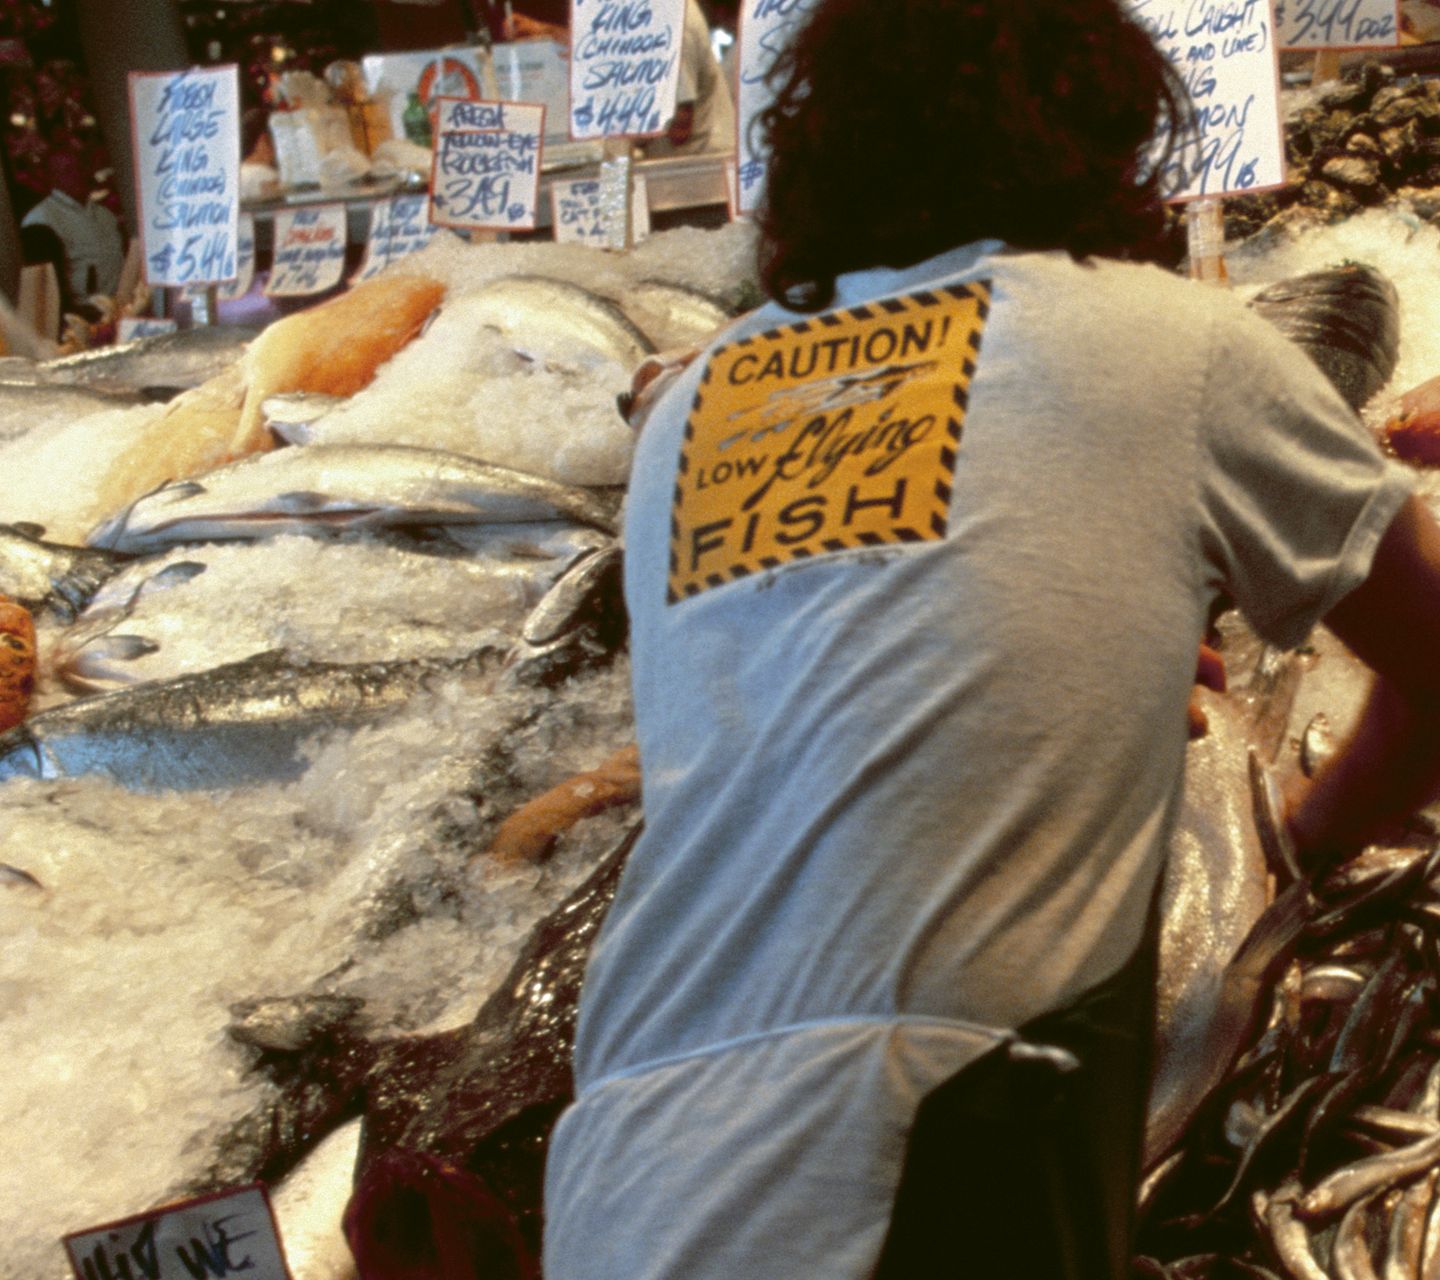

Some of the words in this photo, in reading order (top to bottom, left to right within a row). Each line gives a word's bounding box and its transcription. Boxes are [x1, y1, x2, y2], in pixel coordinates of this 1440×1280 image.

[591, 0, 653, 34] KING
[1354, 14, 1397, 42] DOZ
[582, 49, 678, 90] SALMON
[729, 316, 952, 386] CAUTION!
[696, 454, 769, 491] LOW
[690, 477, 909, 572] FISH
